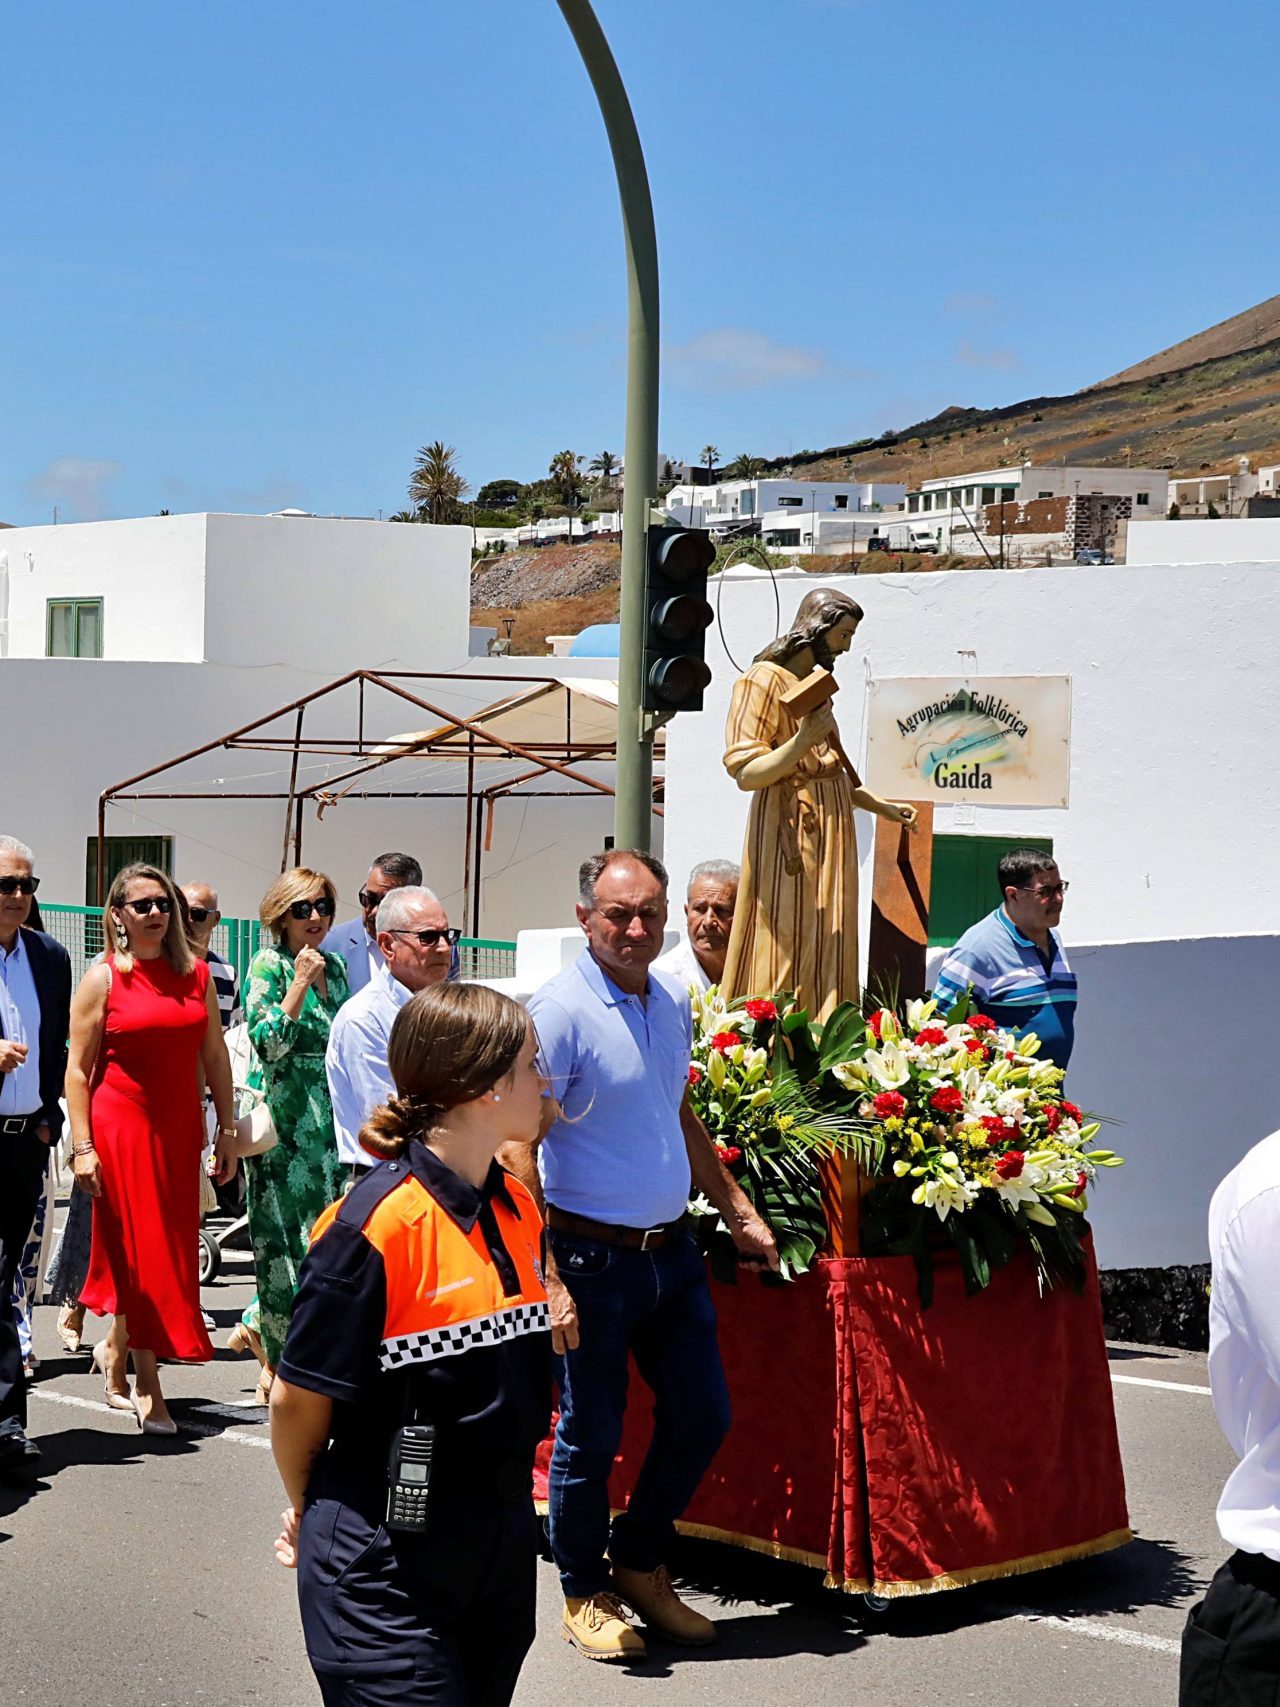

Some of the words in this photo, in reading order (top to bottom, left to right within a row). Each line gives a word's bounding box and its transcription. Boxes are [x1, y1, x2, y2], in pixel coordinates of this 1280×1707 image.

[896, 693, 965, 737] Agrupación
[969, 691, 1028, 738] Folklórica
[934, 762, 992, 789] Gaida
